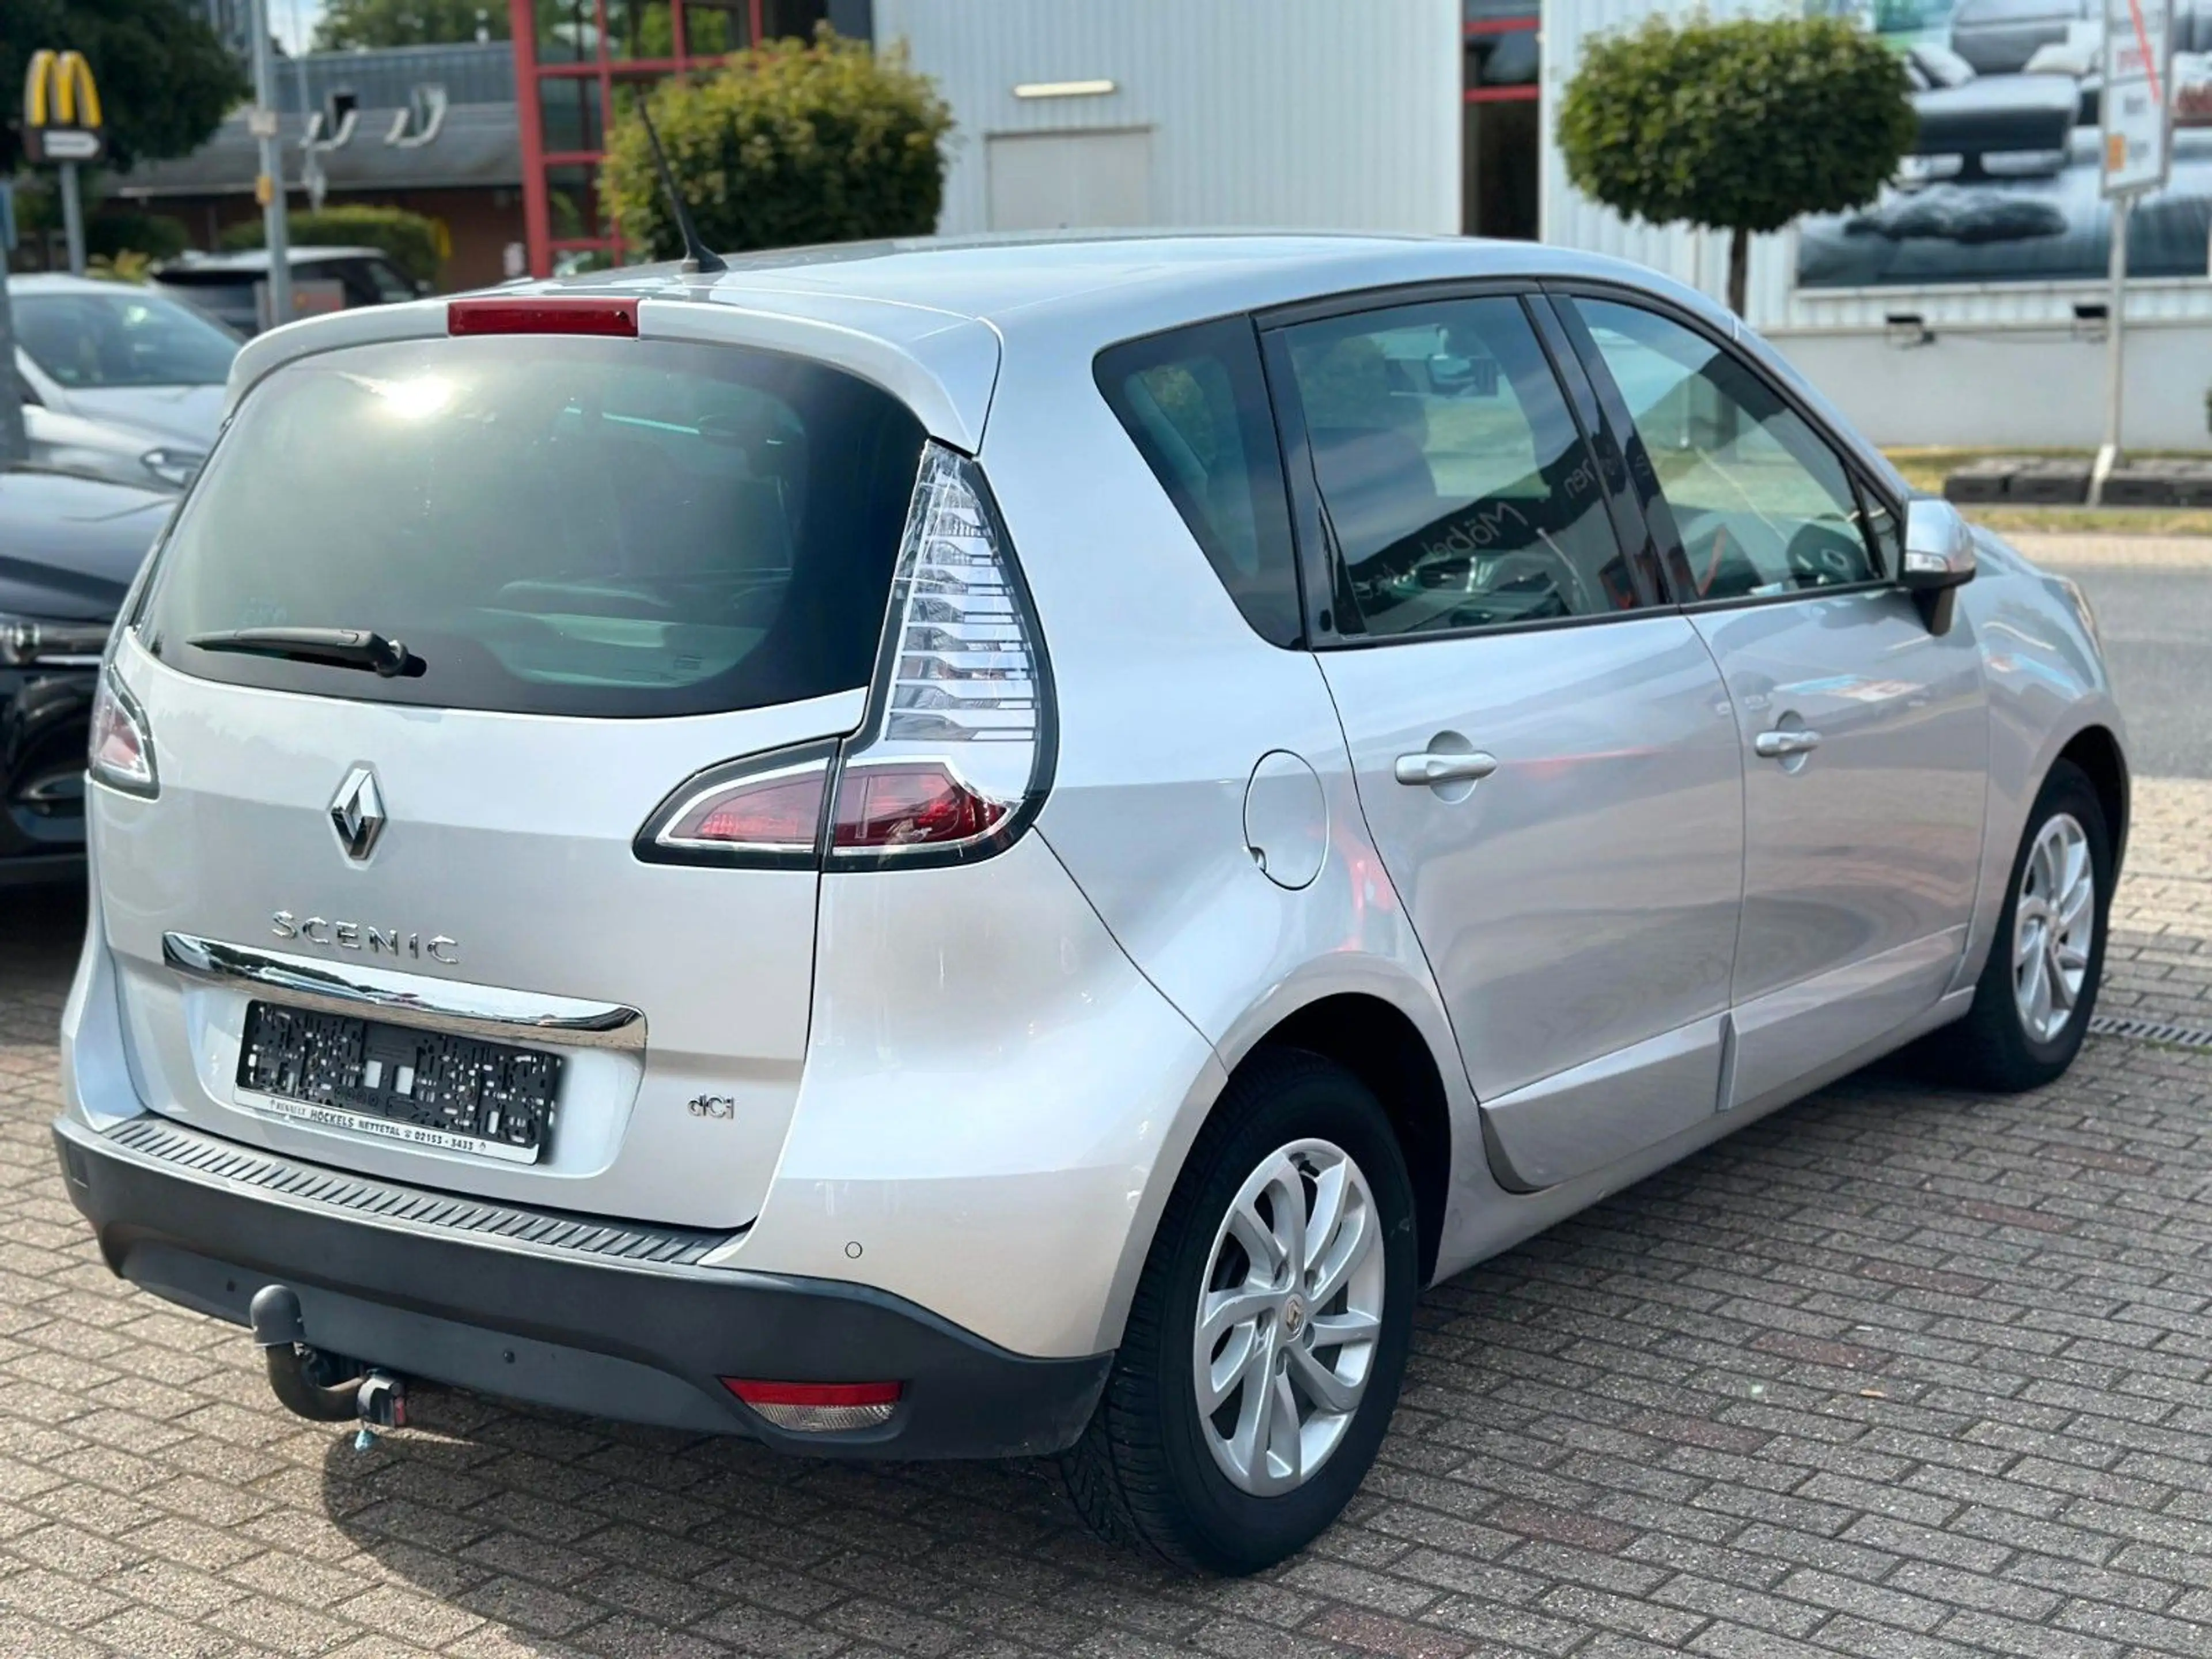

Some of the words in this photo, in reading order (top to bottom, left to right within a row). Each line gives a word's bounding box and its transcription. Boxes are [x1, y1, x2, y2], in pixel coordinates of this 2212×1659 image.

[272, 910, 459, 964] SCENIC
[359, 1120, 400, 1136] NETTETAL
[414, 1131, 442, 1144] 02153
[451, 1138, 474, 1150] 3433
